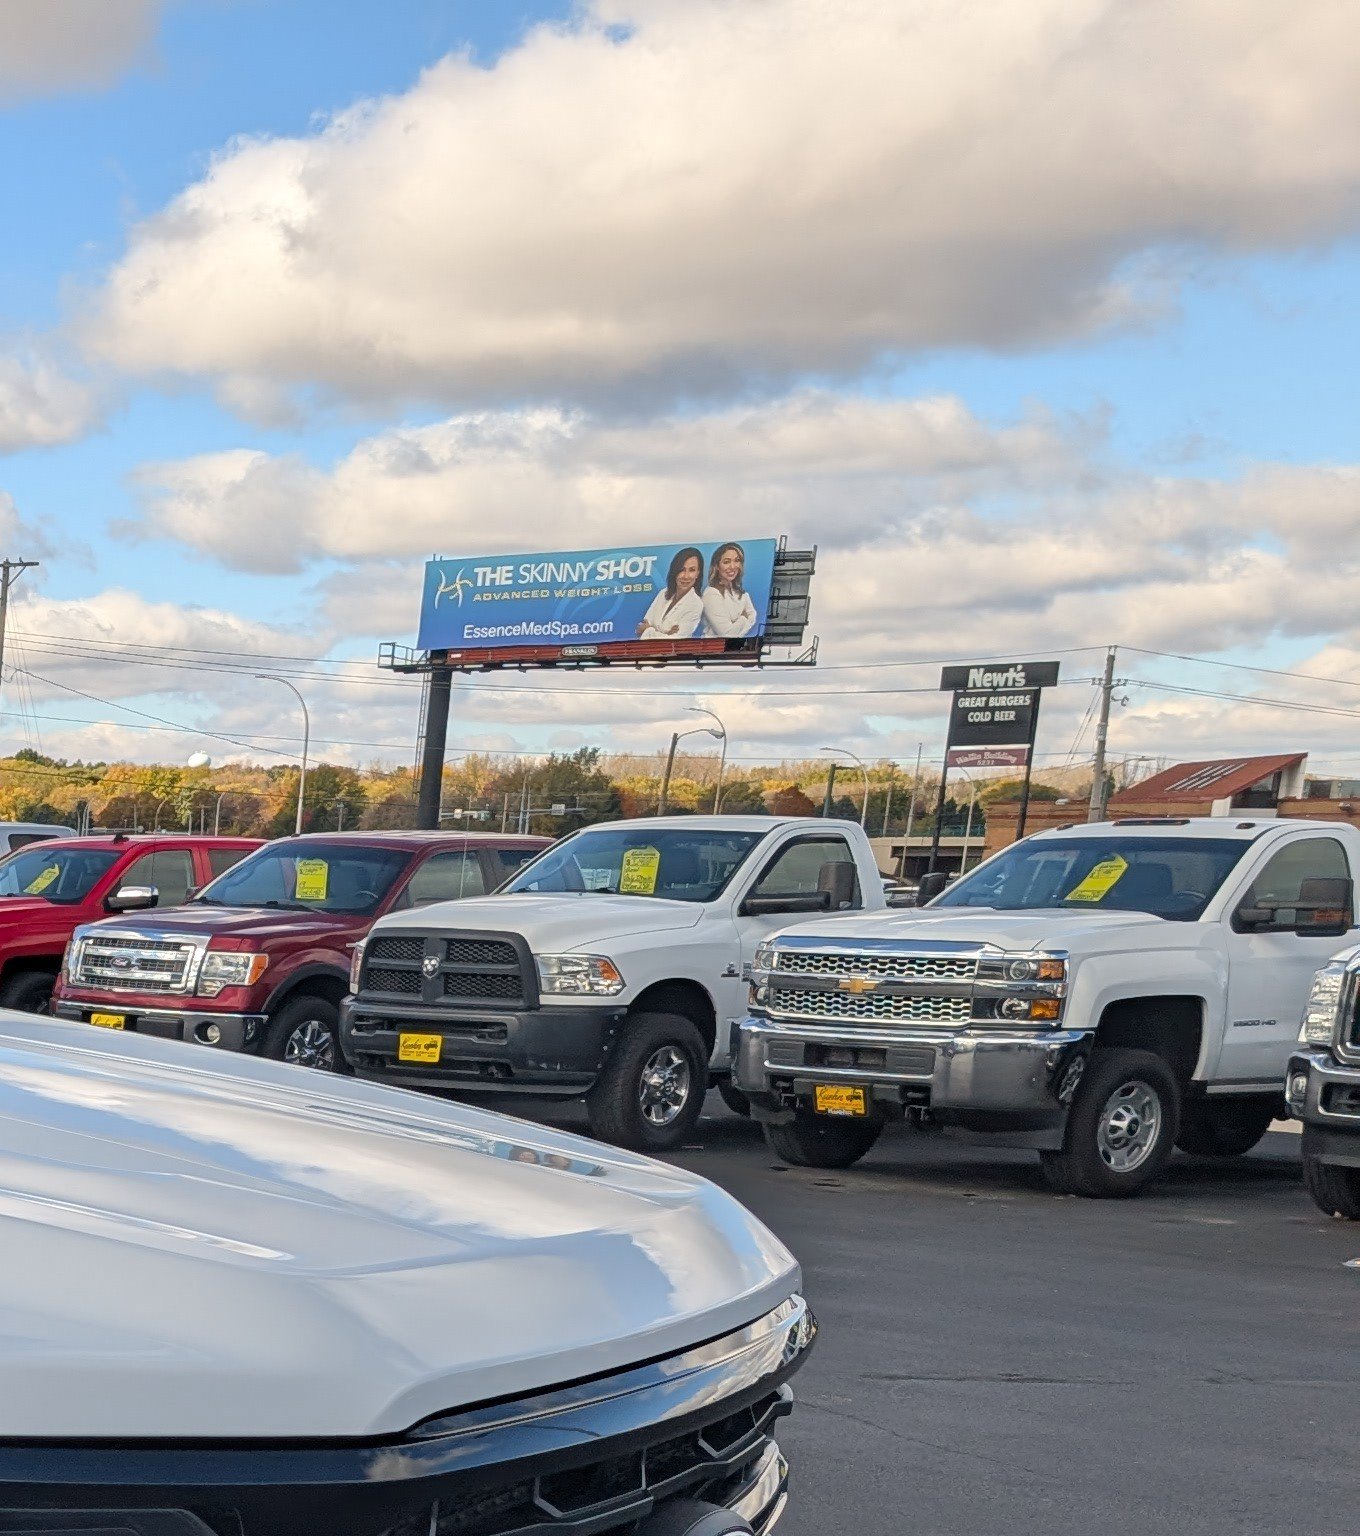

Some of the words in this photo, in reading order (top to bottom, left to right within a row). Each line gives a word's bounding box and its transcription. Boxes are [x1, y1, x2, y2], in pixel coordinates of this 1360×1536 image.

[473, 566, 513, 587] THE
[518, 561, 597, 584] SKINNY
[596, 555, 658, 578] SHOT
[472, 589, 550, 602] ADVANCED
[553, 586, 609, 599] WEIGHT
[613, 582, 653, 594] LOSS
[463, 619, 614, 639] EssenceMedSpa.com
[967, 664, 1026, 688] Newt's
[958, 695, 987, 708] GREAT
[988, 694, 1030, 707] BURGERS
[967, 711, 991, 723] COLD
[994, 710, 1016, 721] BEER
